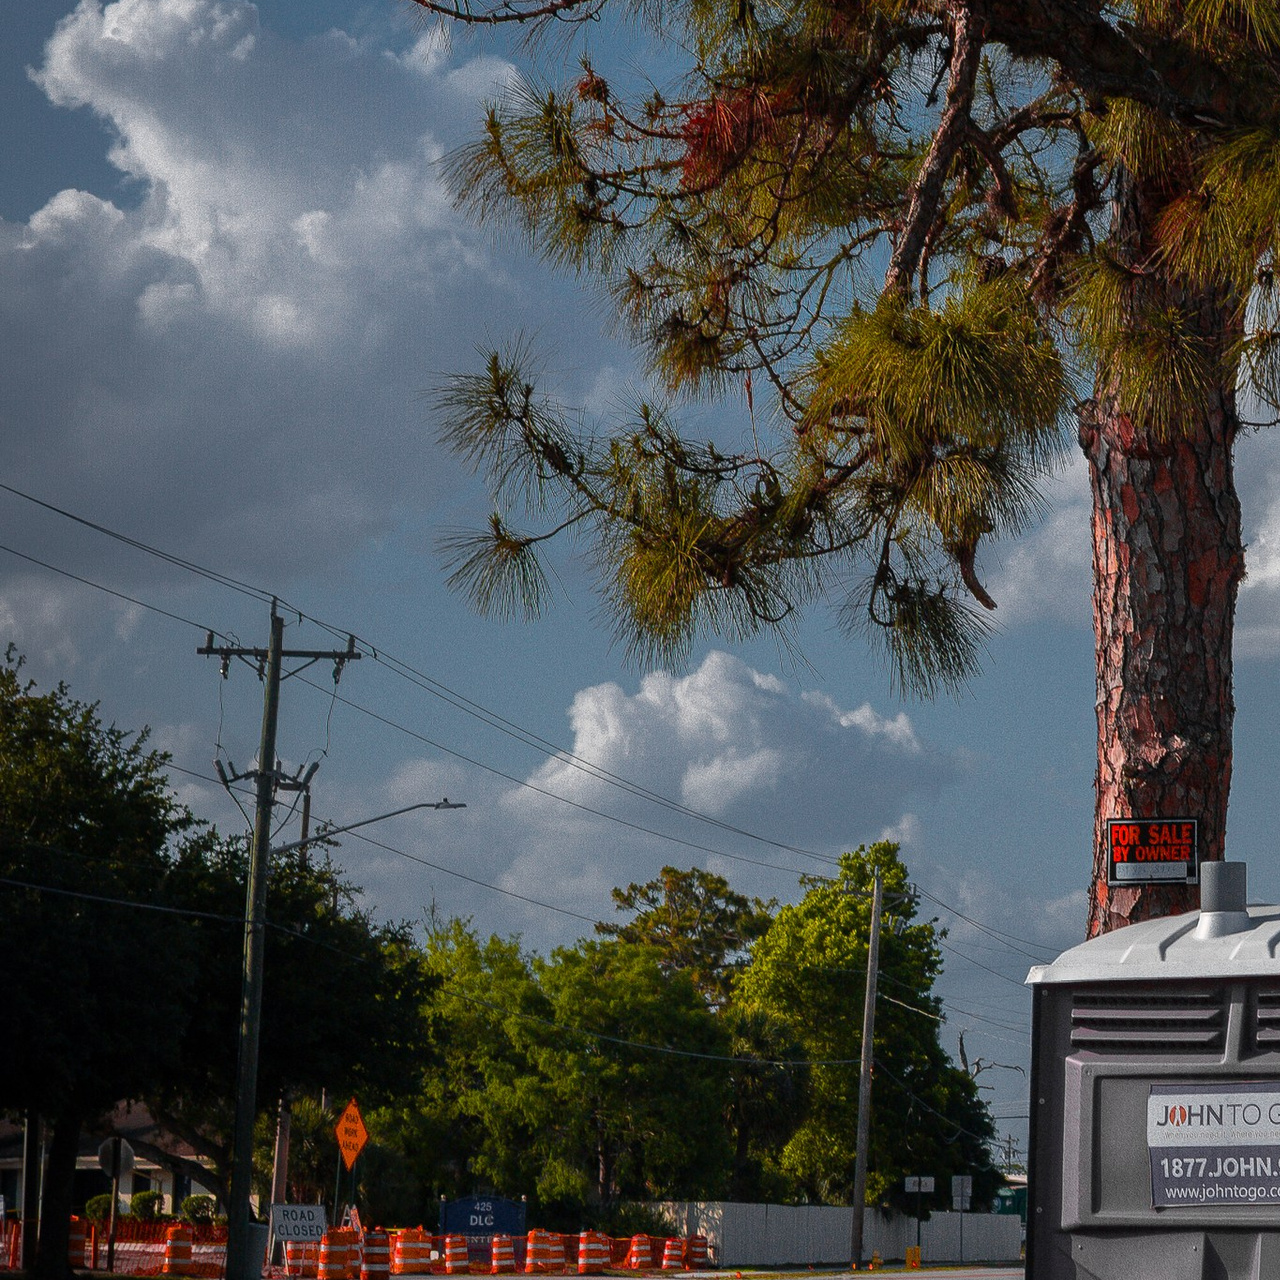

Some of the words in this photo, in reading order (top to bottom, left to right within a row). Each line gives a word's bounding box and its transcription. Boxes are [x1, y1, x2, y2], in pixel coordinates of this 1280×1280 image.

[1111, 825, 1140, 845] FOR
[1148, 824, 1193, 845] SALE
[1113, 846, 1130, 862] BY
[1135, 845, 1190, 861] OWNER
[282, 1210, 315, 1222] ROAD
[470, 1215, 494, 1226] DLC
[278, 1224, 323, 1236] CLOSED
